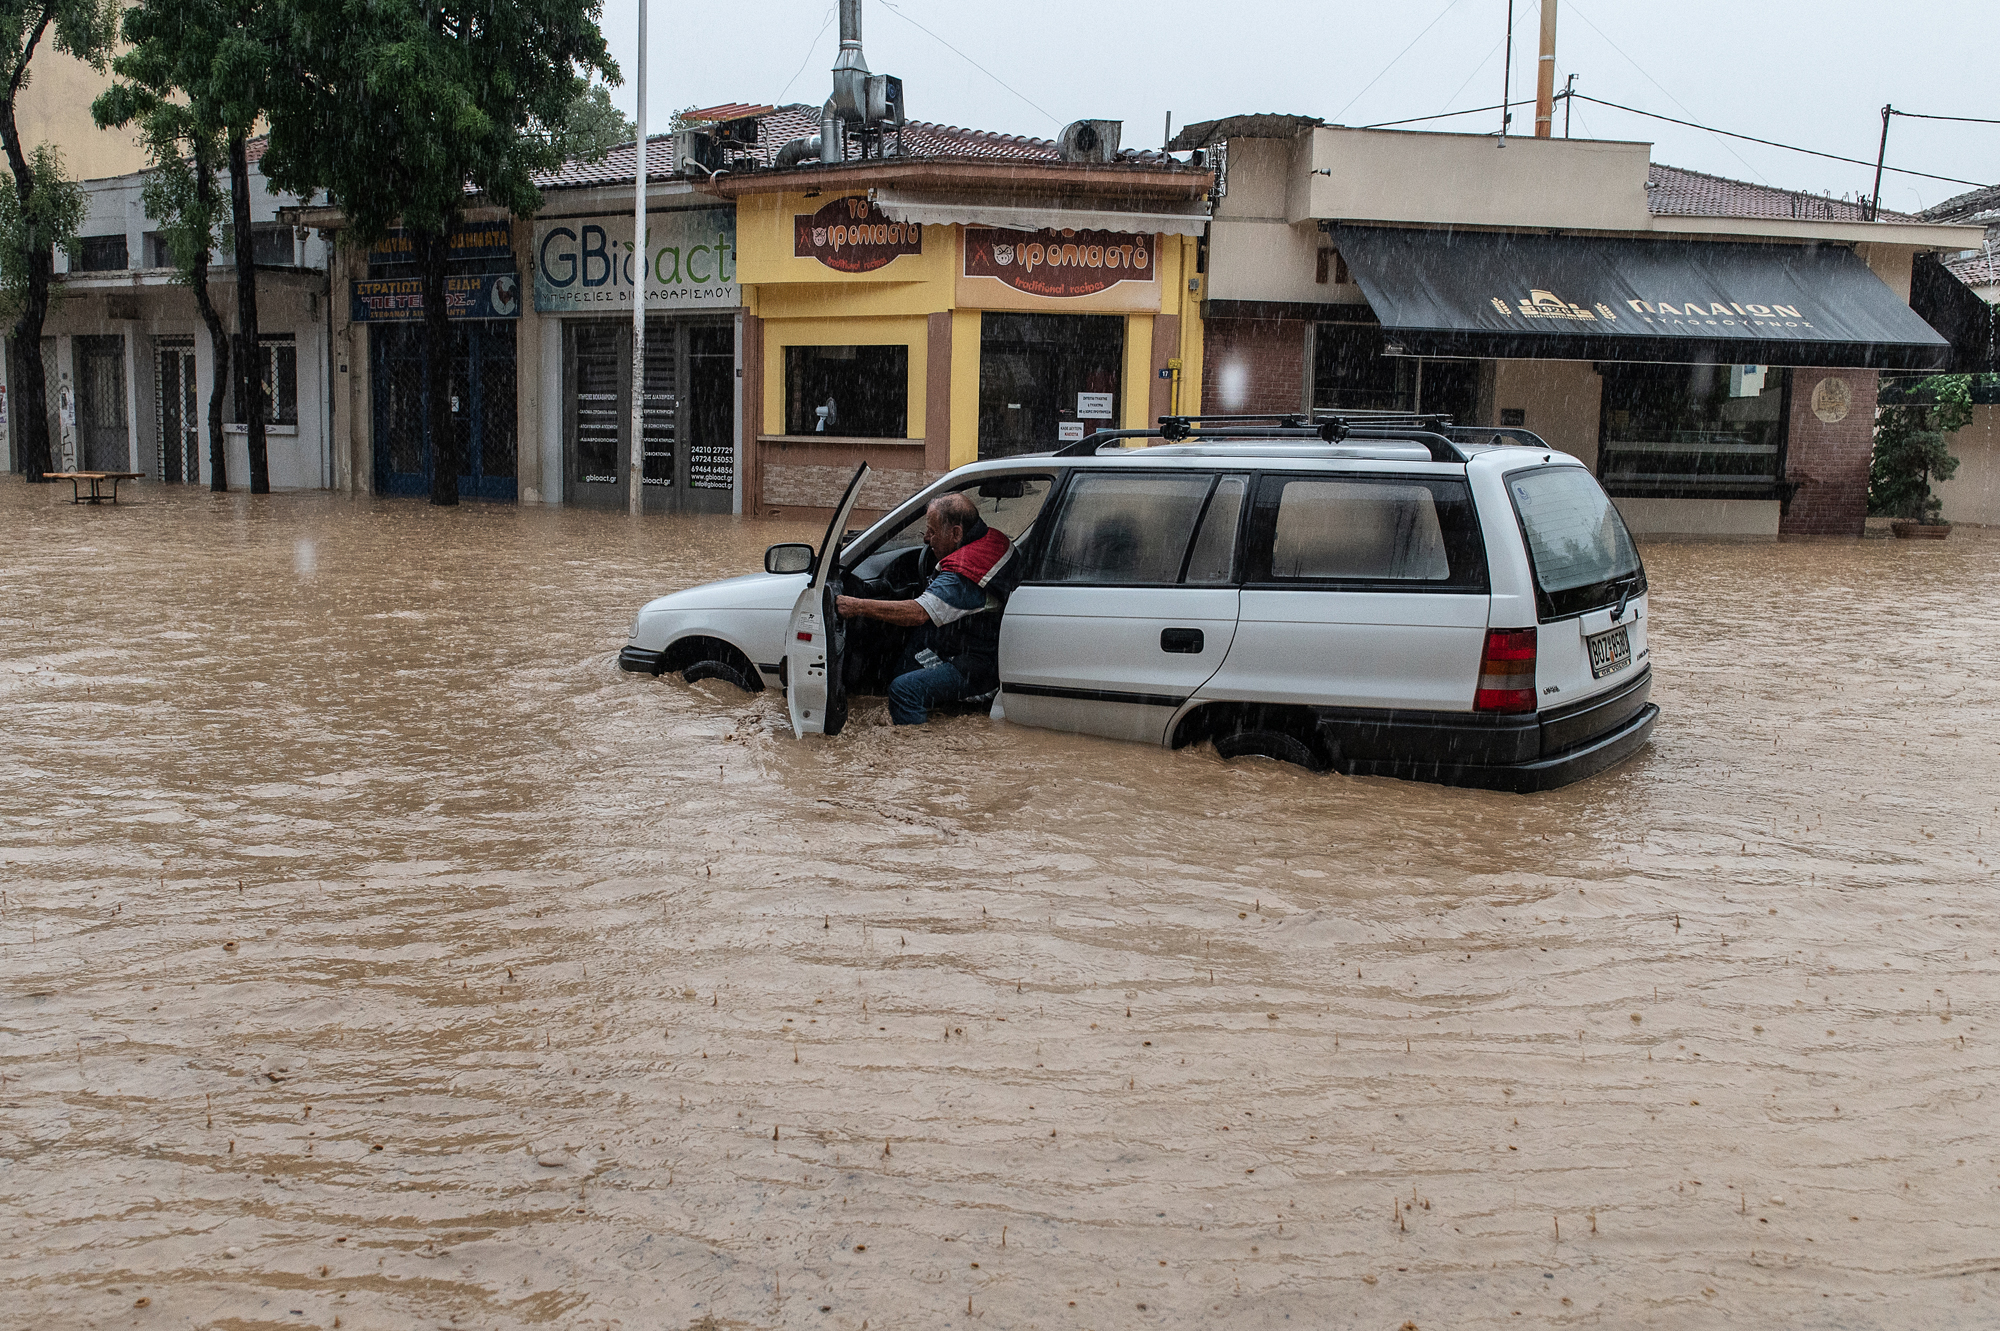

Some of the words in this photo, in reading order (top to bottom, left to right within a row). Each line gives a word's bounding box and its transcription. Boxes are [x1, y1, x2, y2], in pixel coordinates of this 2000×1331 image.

[449, 230, 509, 249] ΟΔΗΜΑΤΑ
[357, 281, 423, 295] ΣΤΡΑΤΙΩΤΙ
[448, 279, 481, 291] ΕΙΔΗ
[1015, 276, 1065, 294] traditional
[1069, 281, 1105, 293] recipes
[542, 292, 614, 303] ΥΠΗΡΕΣΙΕΣ
[619, 287, 732, 301] ΒΙΑΘΑΡΙΣΜΟΥ
[1627, 299, 1803, 319] ΠΑΛΑΙΩΝ
[712, 446, 734, 454] 27729
[691, 474, 733, 482] www.gbioact.gr
[712, 466, 733, 474] 64856
[585, 475, 617, 483] gbioact.gr
